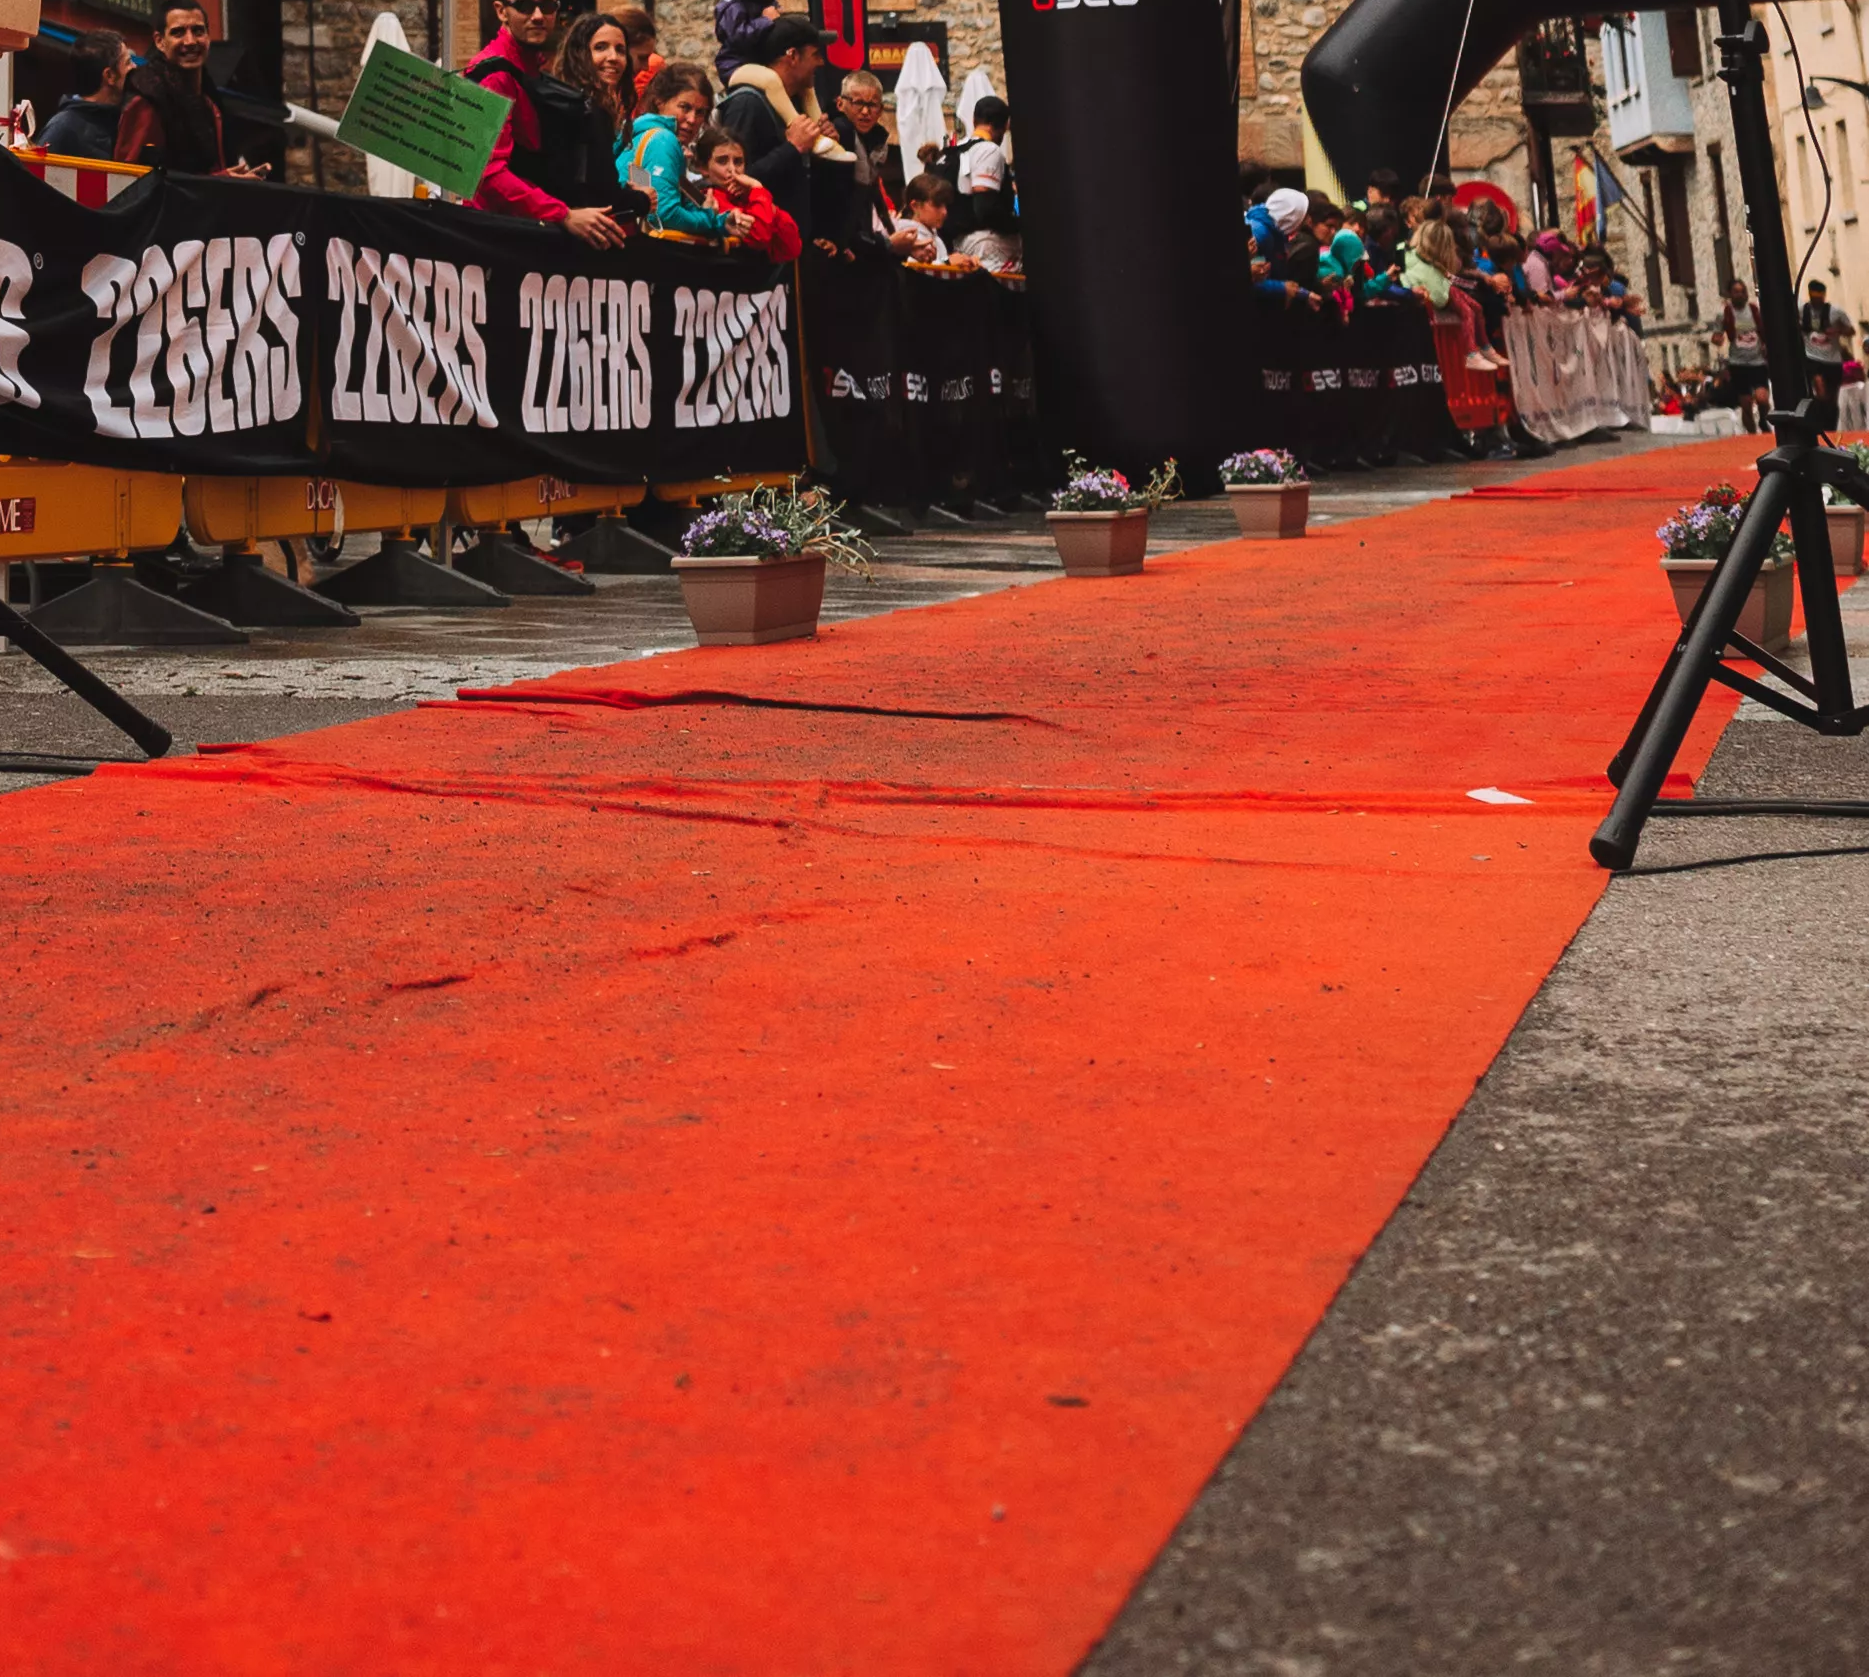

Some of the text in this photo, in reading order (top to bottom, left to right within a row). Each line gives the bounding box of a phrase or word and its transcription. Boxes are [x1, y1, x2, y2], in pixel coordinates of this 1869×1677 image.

[80, 233, 304, 439] 226ERS
[325, 237, 499, 428] 226ERS
[520, 271, 654, 433] 226ERS
